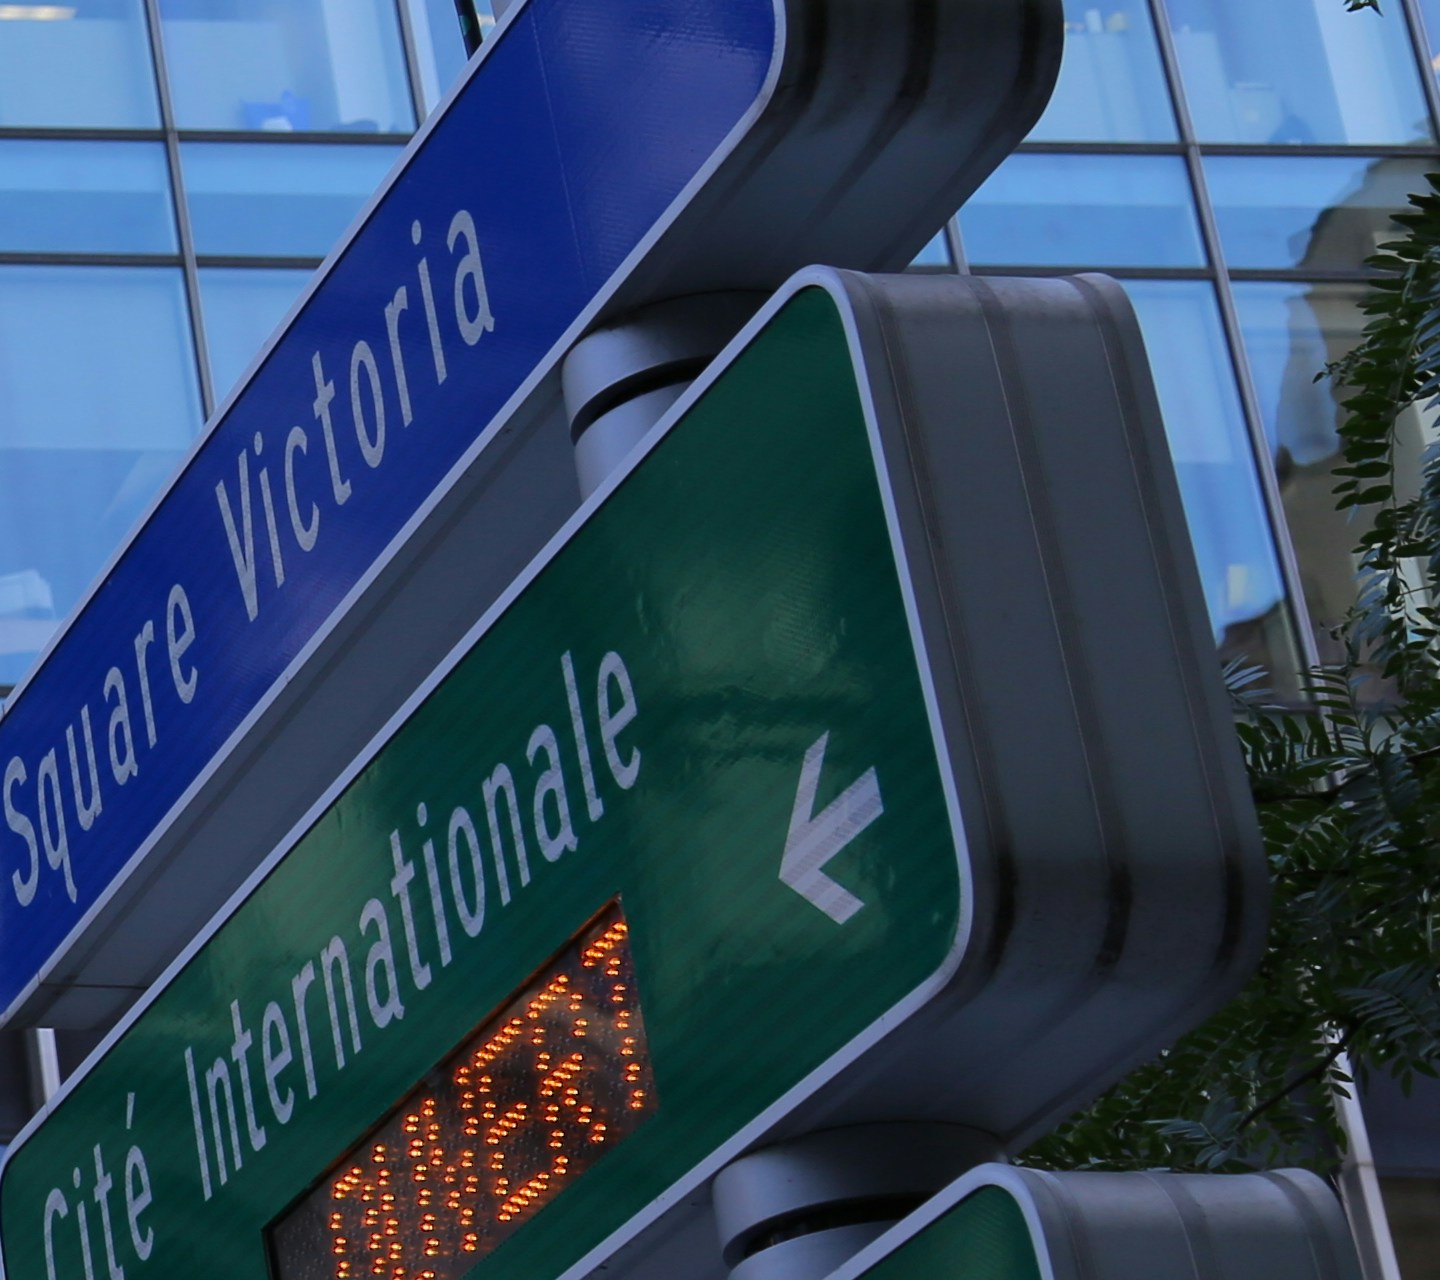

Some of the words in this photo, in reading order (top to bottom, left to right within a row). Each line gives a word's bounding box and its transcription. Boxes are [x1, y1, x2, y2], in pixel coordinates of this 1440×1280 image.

[2, 583, 199, 908] Square
[215, 209, 496, 622] Victoria
[184, 649, 642, 1202] Internationale
